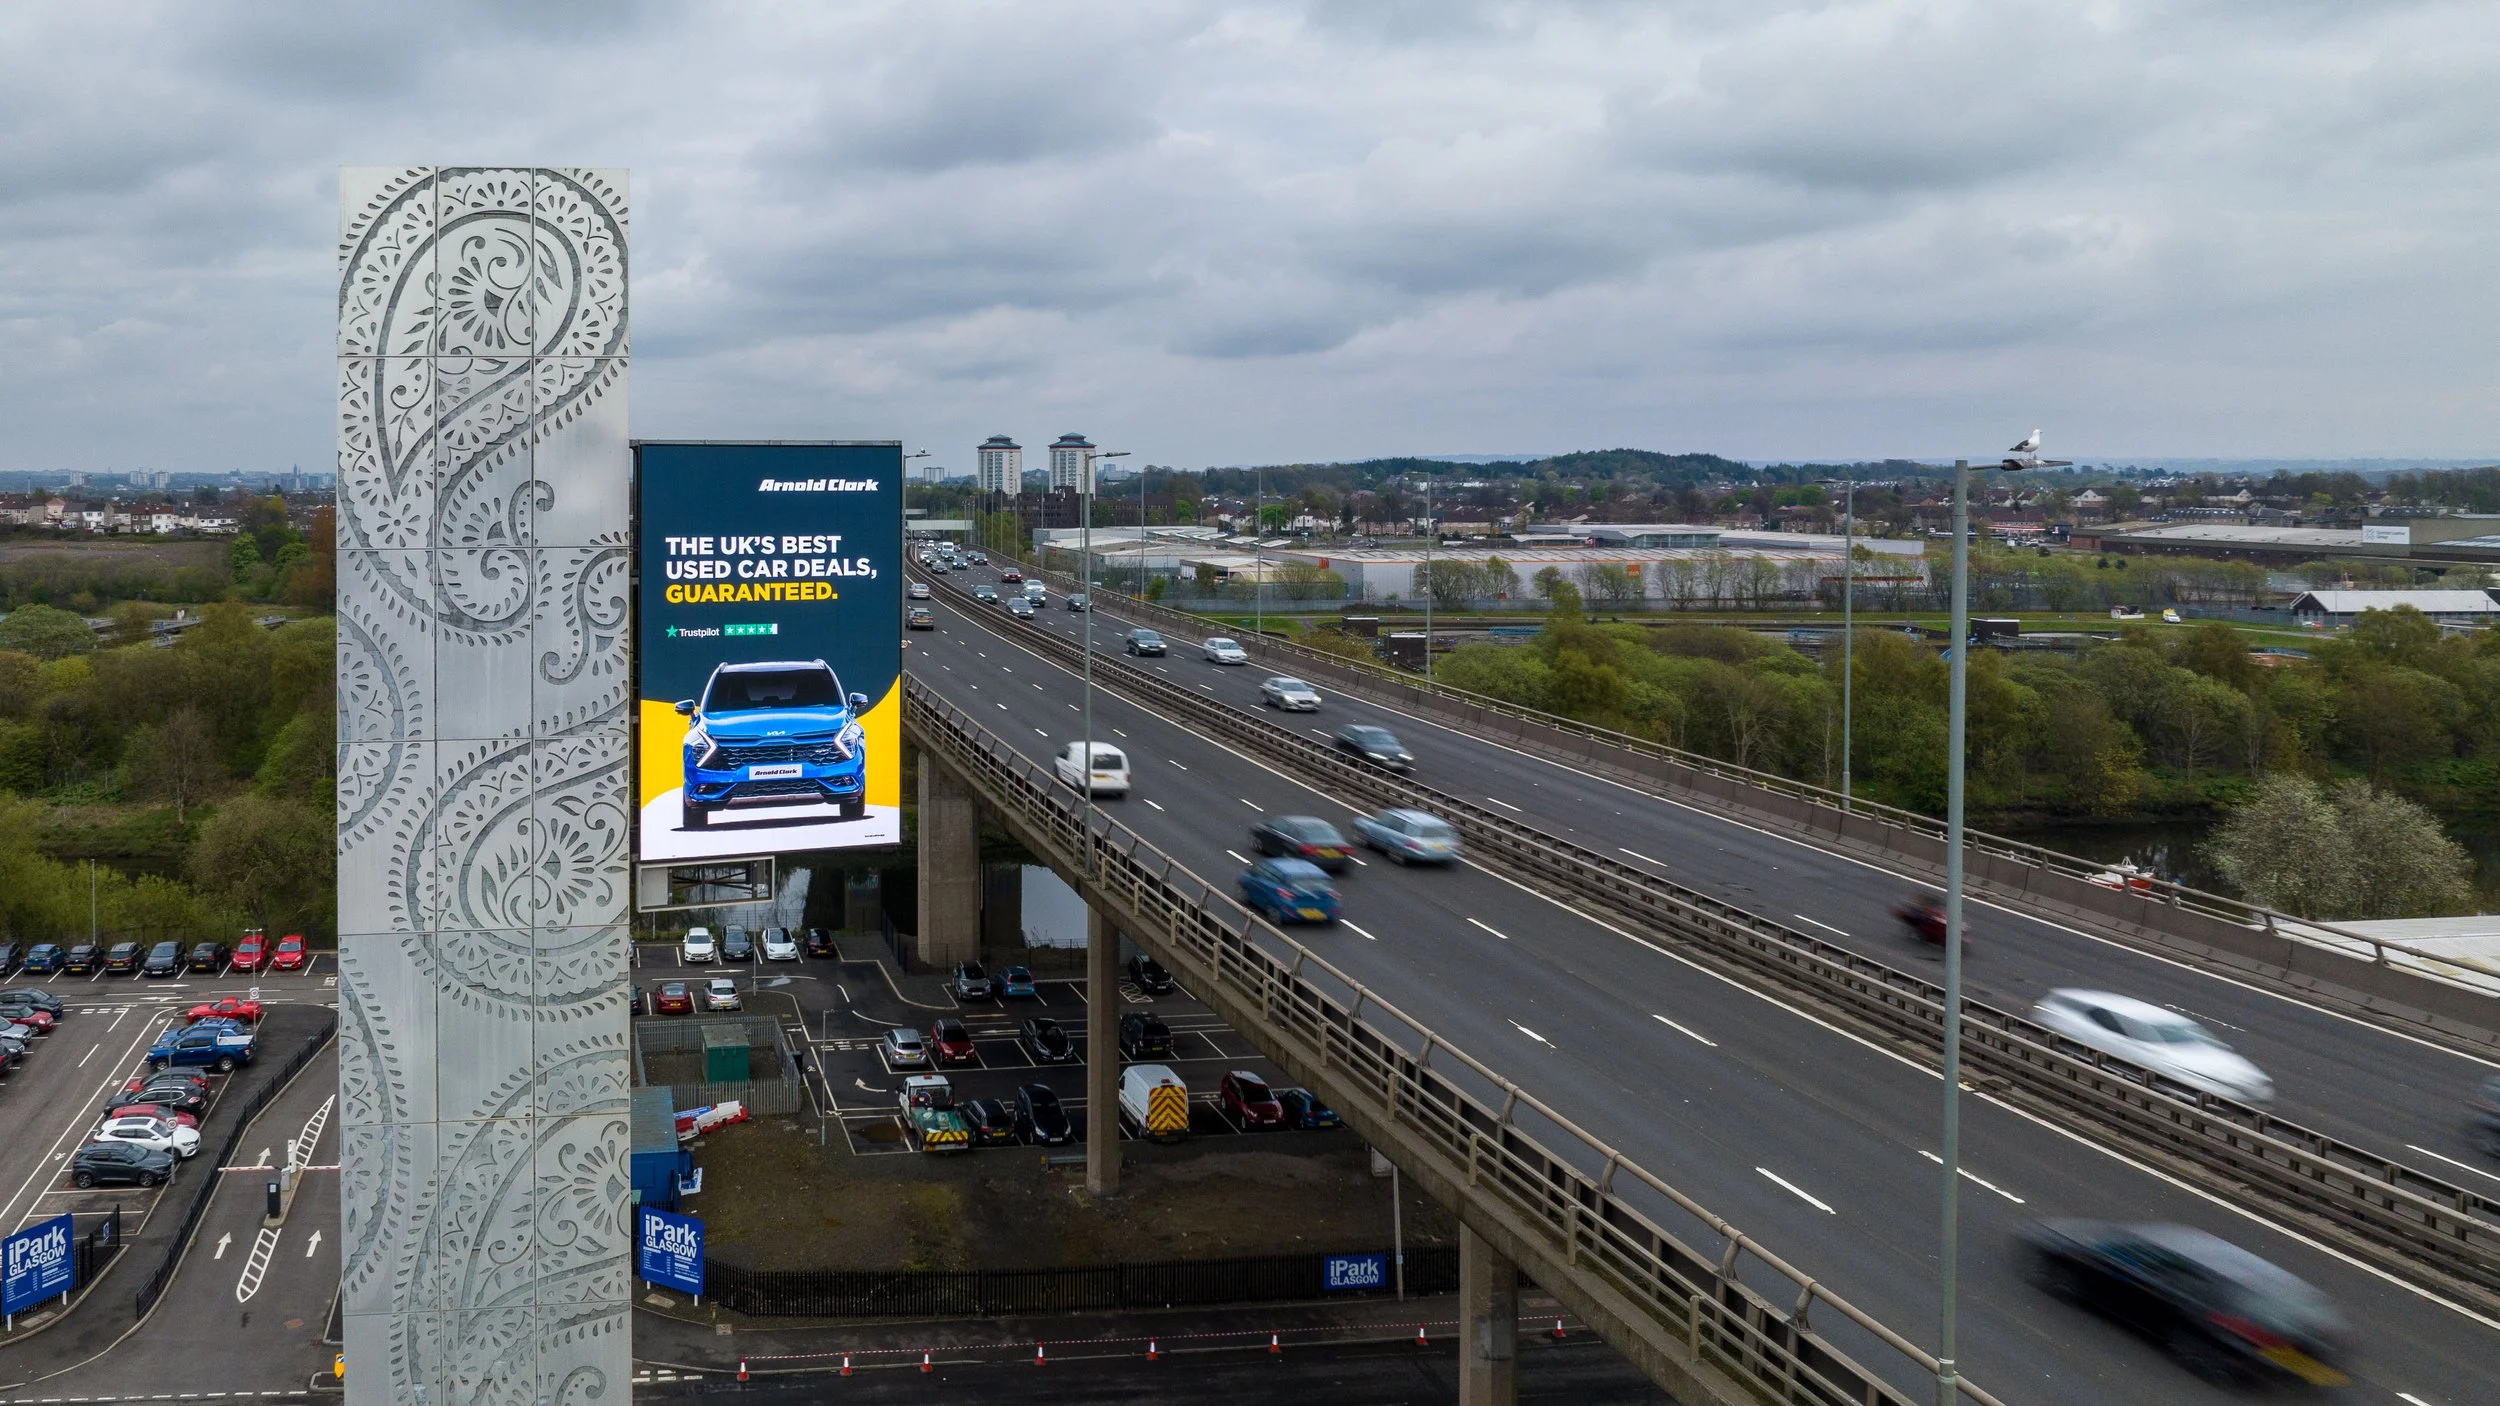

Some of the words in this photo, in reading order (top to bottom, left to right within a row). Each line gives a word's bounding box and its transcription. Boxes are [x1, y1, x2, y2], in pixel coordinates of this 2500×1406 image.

[758, 479, 826, 492] Arnold
[828, 478, 879, 491] Clark
[665, 537, 714, 556] THE
[720, 536, 776, 555] UK’S
[782, 535, 842, 554] BEST
[666, 560, 731, 580] USED
[738, 559, 788, 578] CAR
[794, 558, 878, 579] DEALS,
[665, 582, 838, 604] GUARANTEED.
[679, 627, 720, 638] Trustpilot
[779, 767, 797, 775] Clark
[645, 1214, 697, 1247] iPark
[9, 1225, 66, 1266] iPark
[646, 1236, 697, 1258] GLASGOW
[9, 1244, 66, 1277] GLASGOW
[1330, 1259, 1379, 1277] iPark
[1330, 1275, 1379, 1286] GLASGOW
